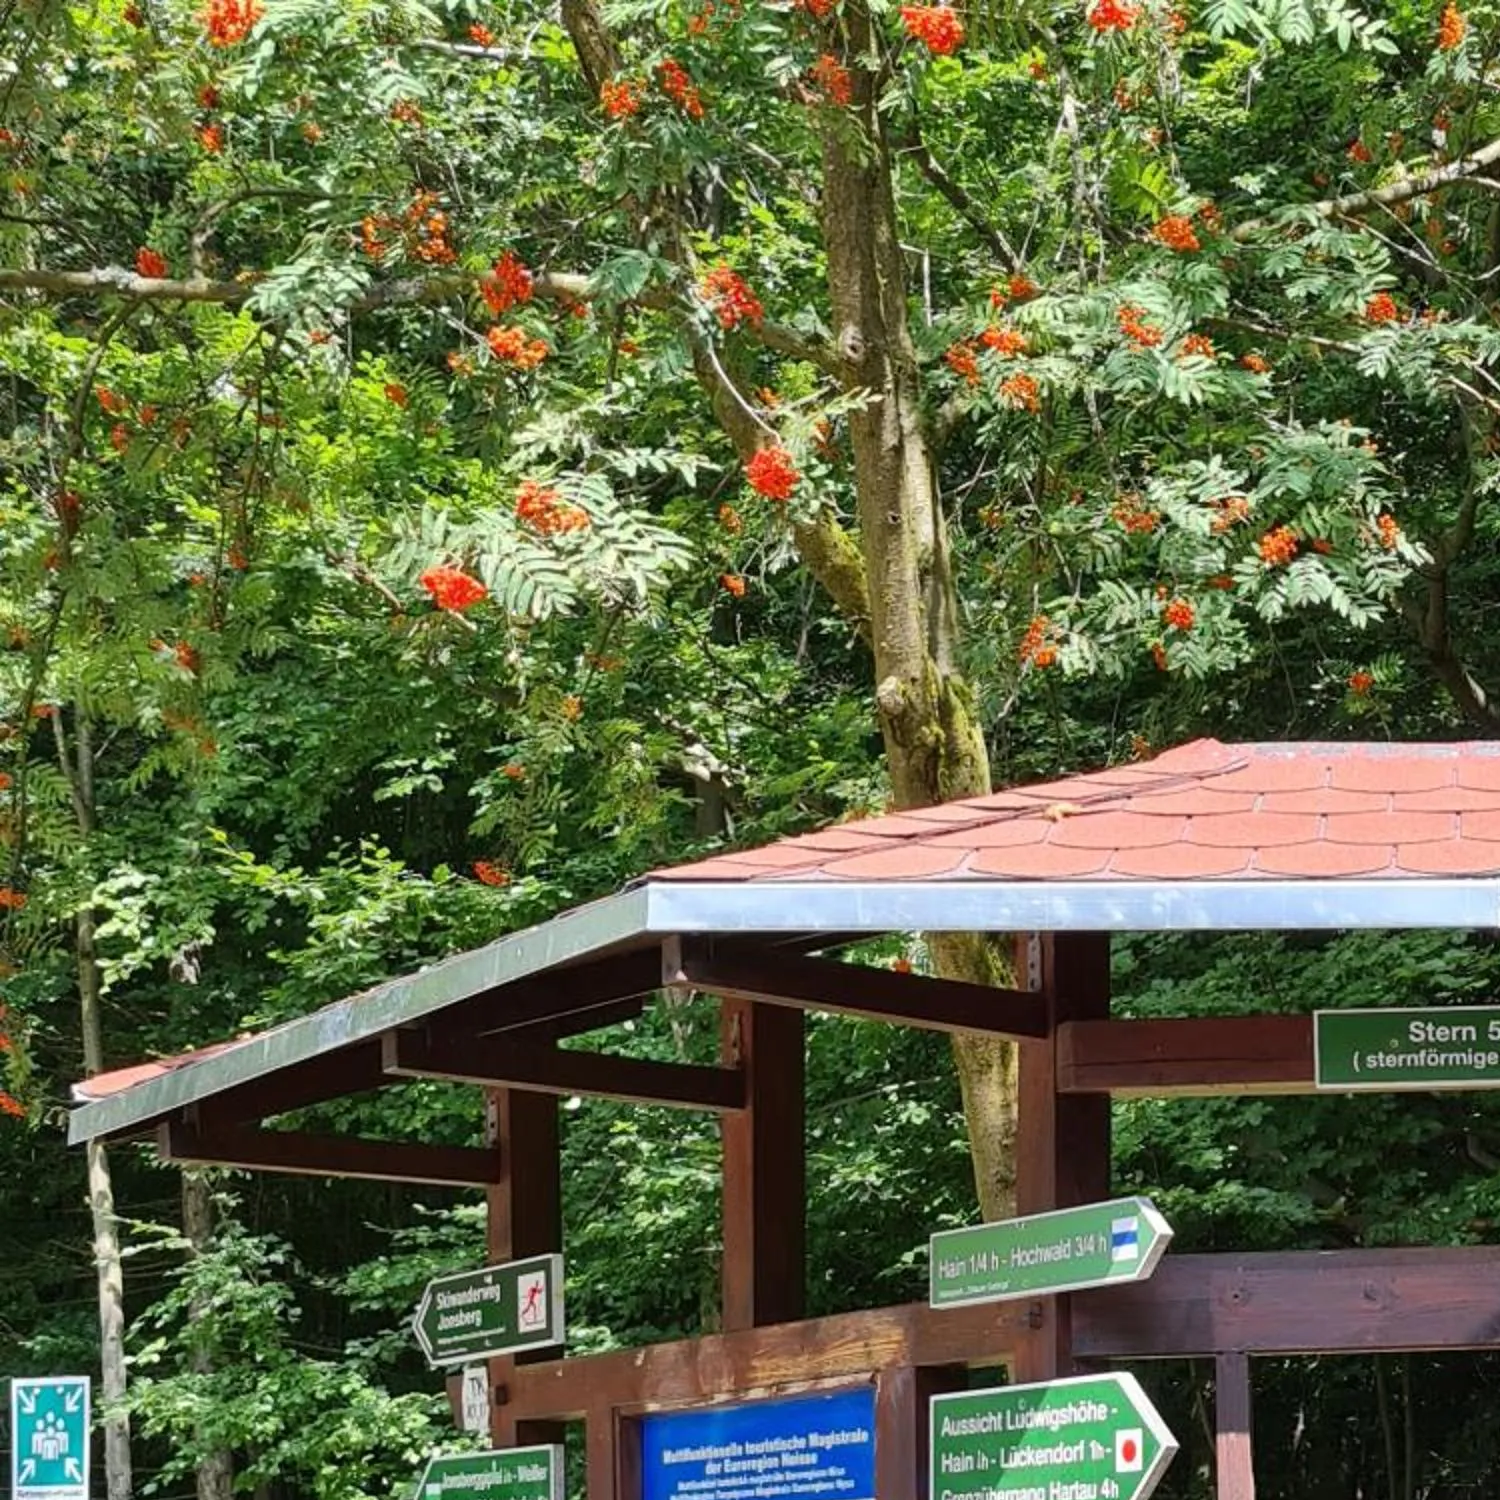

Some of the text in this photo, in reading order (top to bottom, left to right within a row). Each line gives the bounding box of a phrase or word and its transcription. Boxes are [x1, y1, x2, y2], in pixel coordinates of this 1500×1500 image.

[1409, 1020, 1476, 1043] Stern
[939, 1256, 966, 1280] Hain
[970, 1251, 987, 1275] 1/4
[1010, 1238, 1071, 1268] Hochwald
[1075, 1233, 1095, 1257] 3/4
[437, 1284, 501, 1310] Skiwanderweg
[438, 1309, 482, 1330] Jonsberg
[941, 1411, 1003, 1437] Aussicht
[1007, 1400, 1109, 1431] Ludwigshöhe
[705, 1461, 722, 1475] der
[723, 1454, 779, 1474] Euroregion
[941, 1450, 974, 1473] Hain
[1001, 1439, 1085, 1469] Lückendorf
